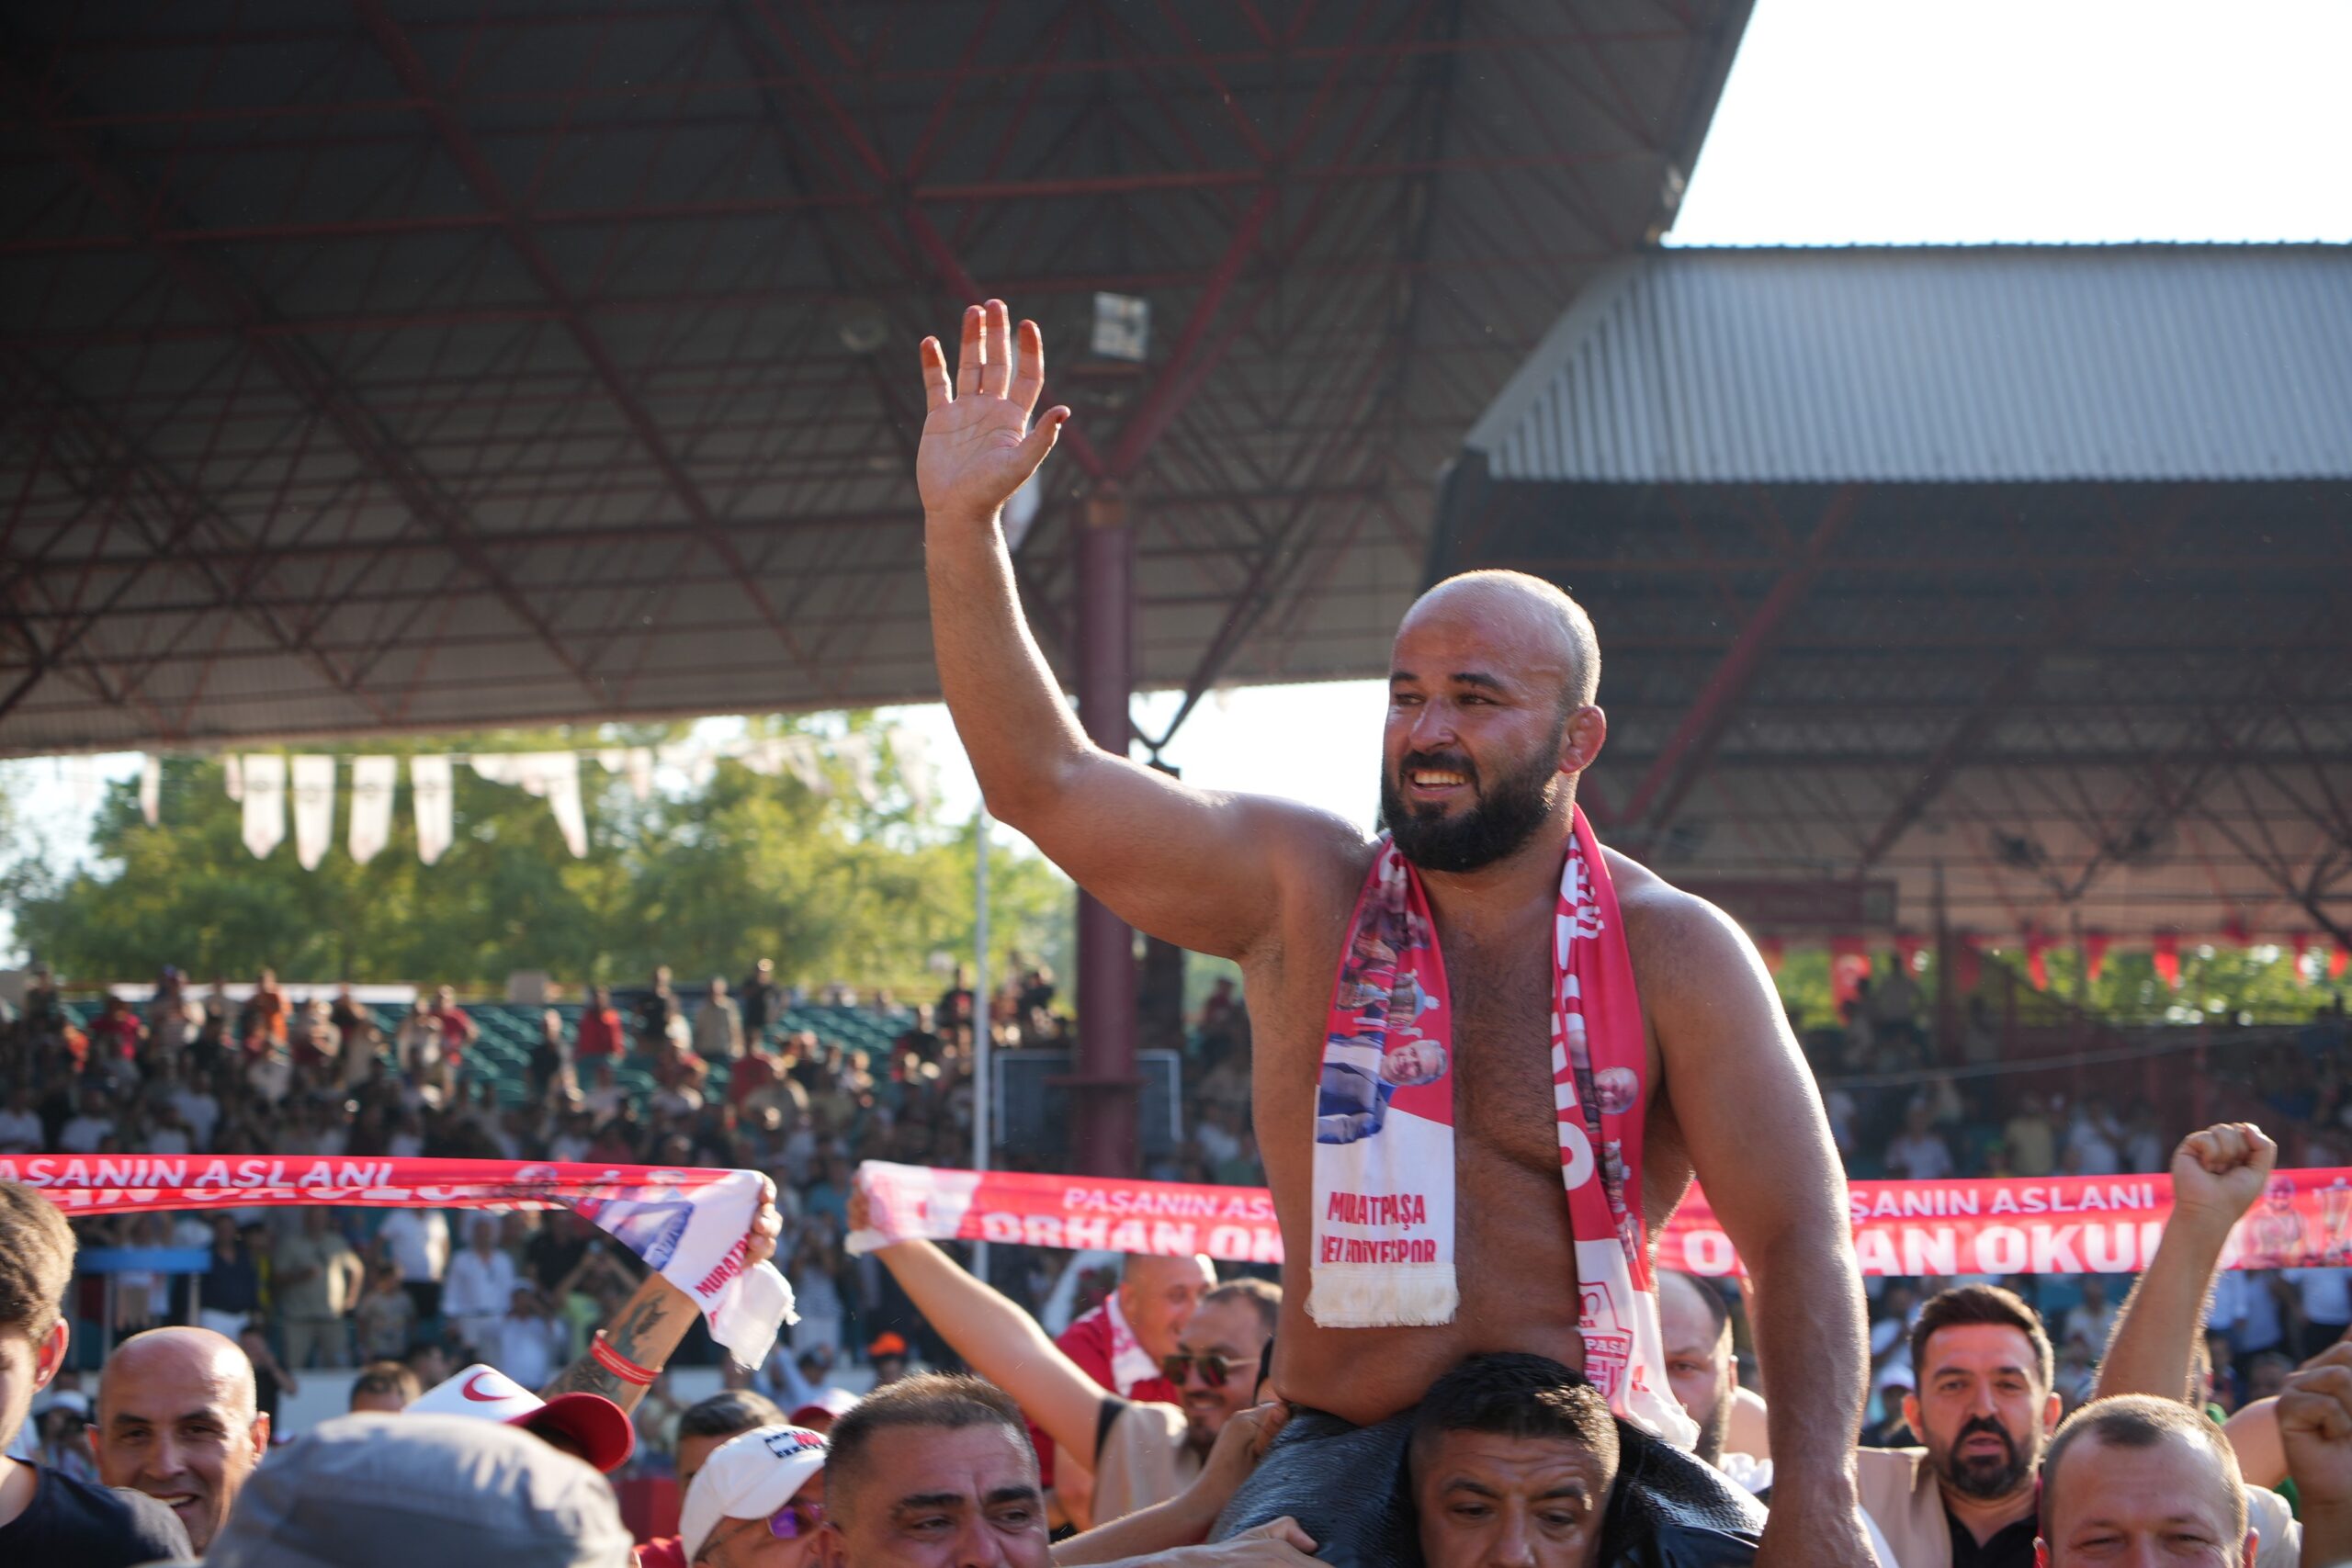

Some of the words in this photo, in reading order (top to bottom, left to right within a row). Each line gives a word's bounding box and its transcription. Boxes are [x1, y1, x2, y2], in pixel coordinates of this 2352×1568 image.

[194, 1158, 393, 1188] ASLANI
[1062, 1187, 1216, 1217] PAŞANIN
[1990, 1182, 2155, 1214] ASLANI
